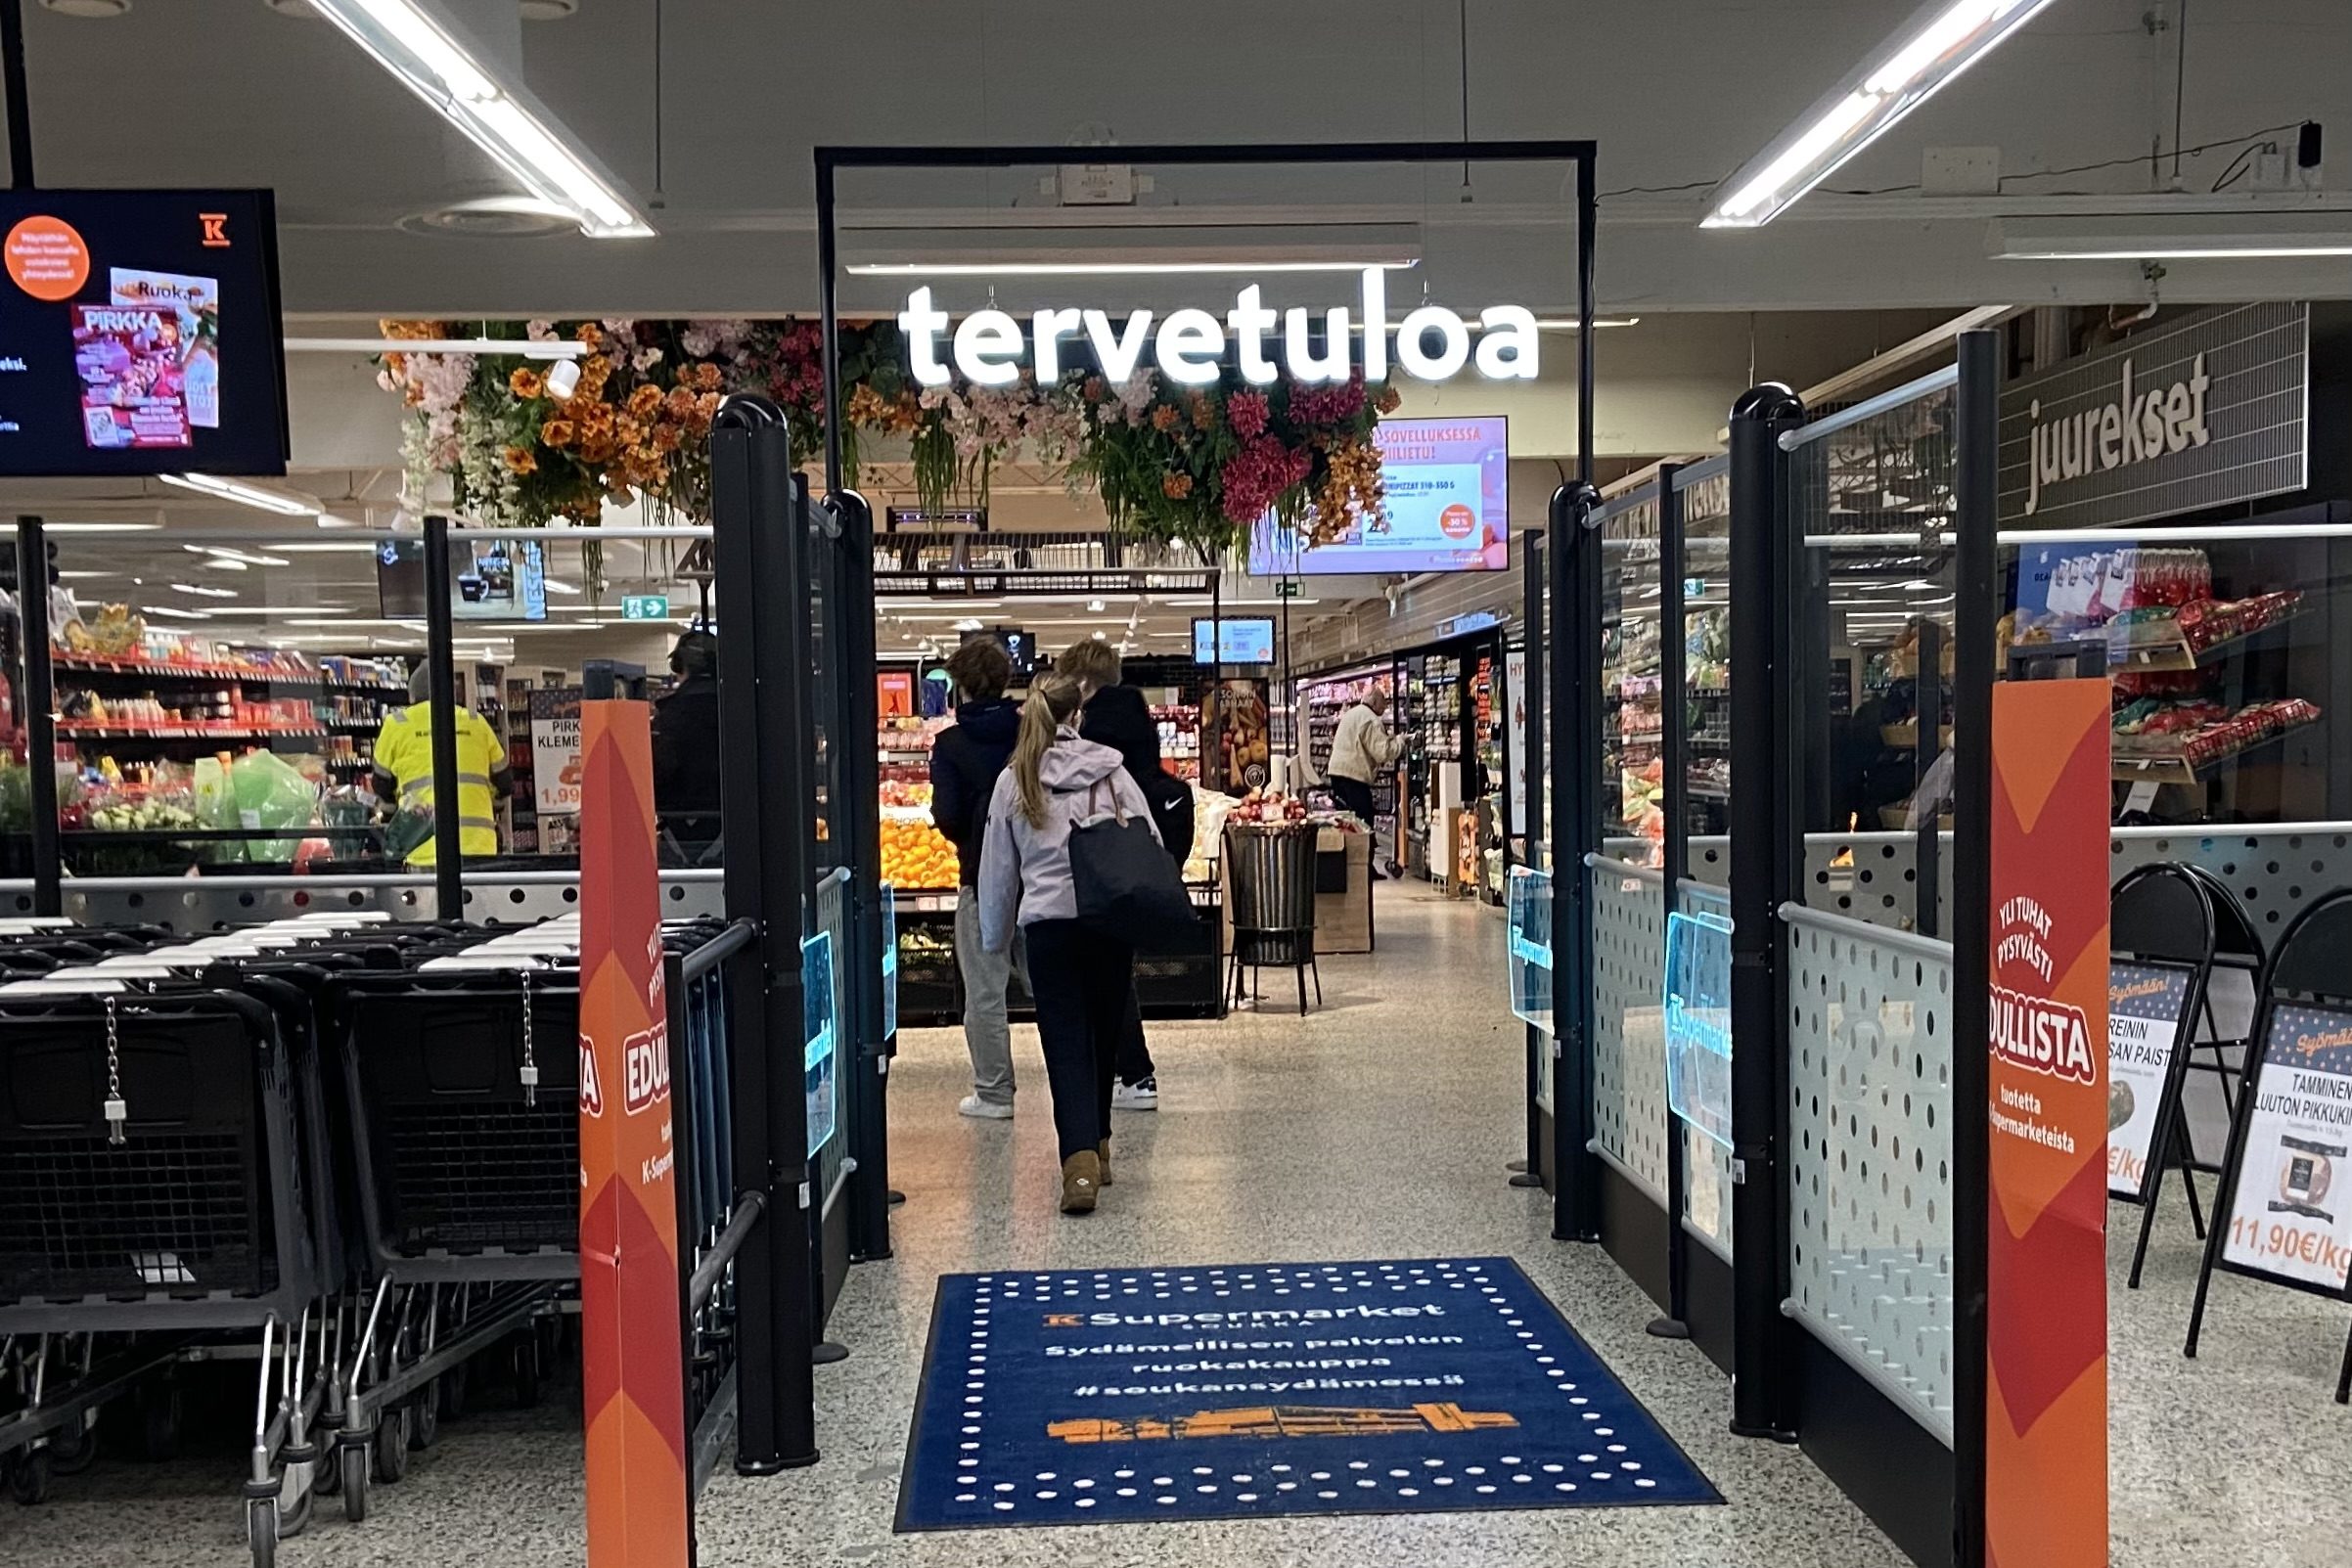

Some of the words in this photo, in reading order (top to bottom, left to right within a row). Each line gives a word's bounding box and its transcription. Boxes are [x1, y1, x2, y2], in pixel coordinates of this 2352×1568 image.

[84, 310, 162, 334] PIRKKA
[898, 266, 1540, 387] tervetuloa
[2025, 351, 2210, 515] juurekset
[1999, 897, 2015, 930] YLI
[2015, 896, 2053, 940] TUHAT
[1998, 931, 2054, 984] PYSYVÄSTI
[1990, 995, 2091, 1073] DULLISTA
[2293, 1073, 2352, 1101] TAMMINEN
[2302, 1099, 2352, 1127] PIKKUKI
[1041, 1314, 1085, 1328] K
[1090, 1304, 1445, 1326] Supermarket
[1305, 1335, 1464, 1349] palvelun
[1132, 1357, 1391, 1373] ruokakauppa
[1074, 1373, 1465, 1397] #soukansydämessä
